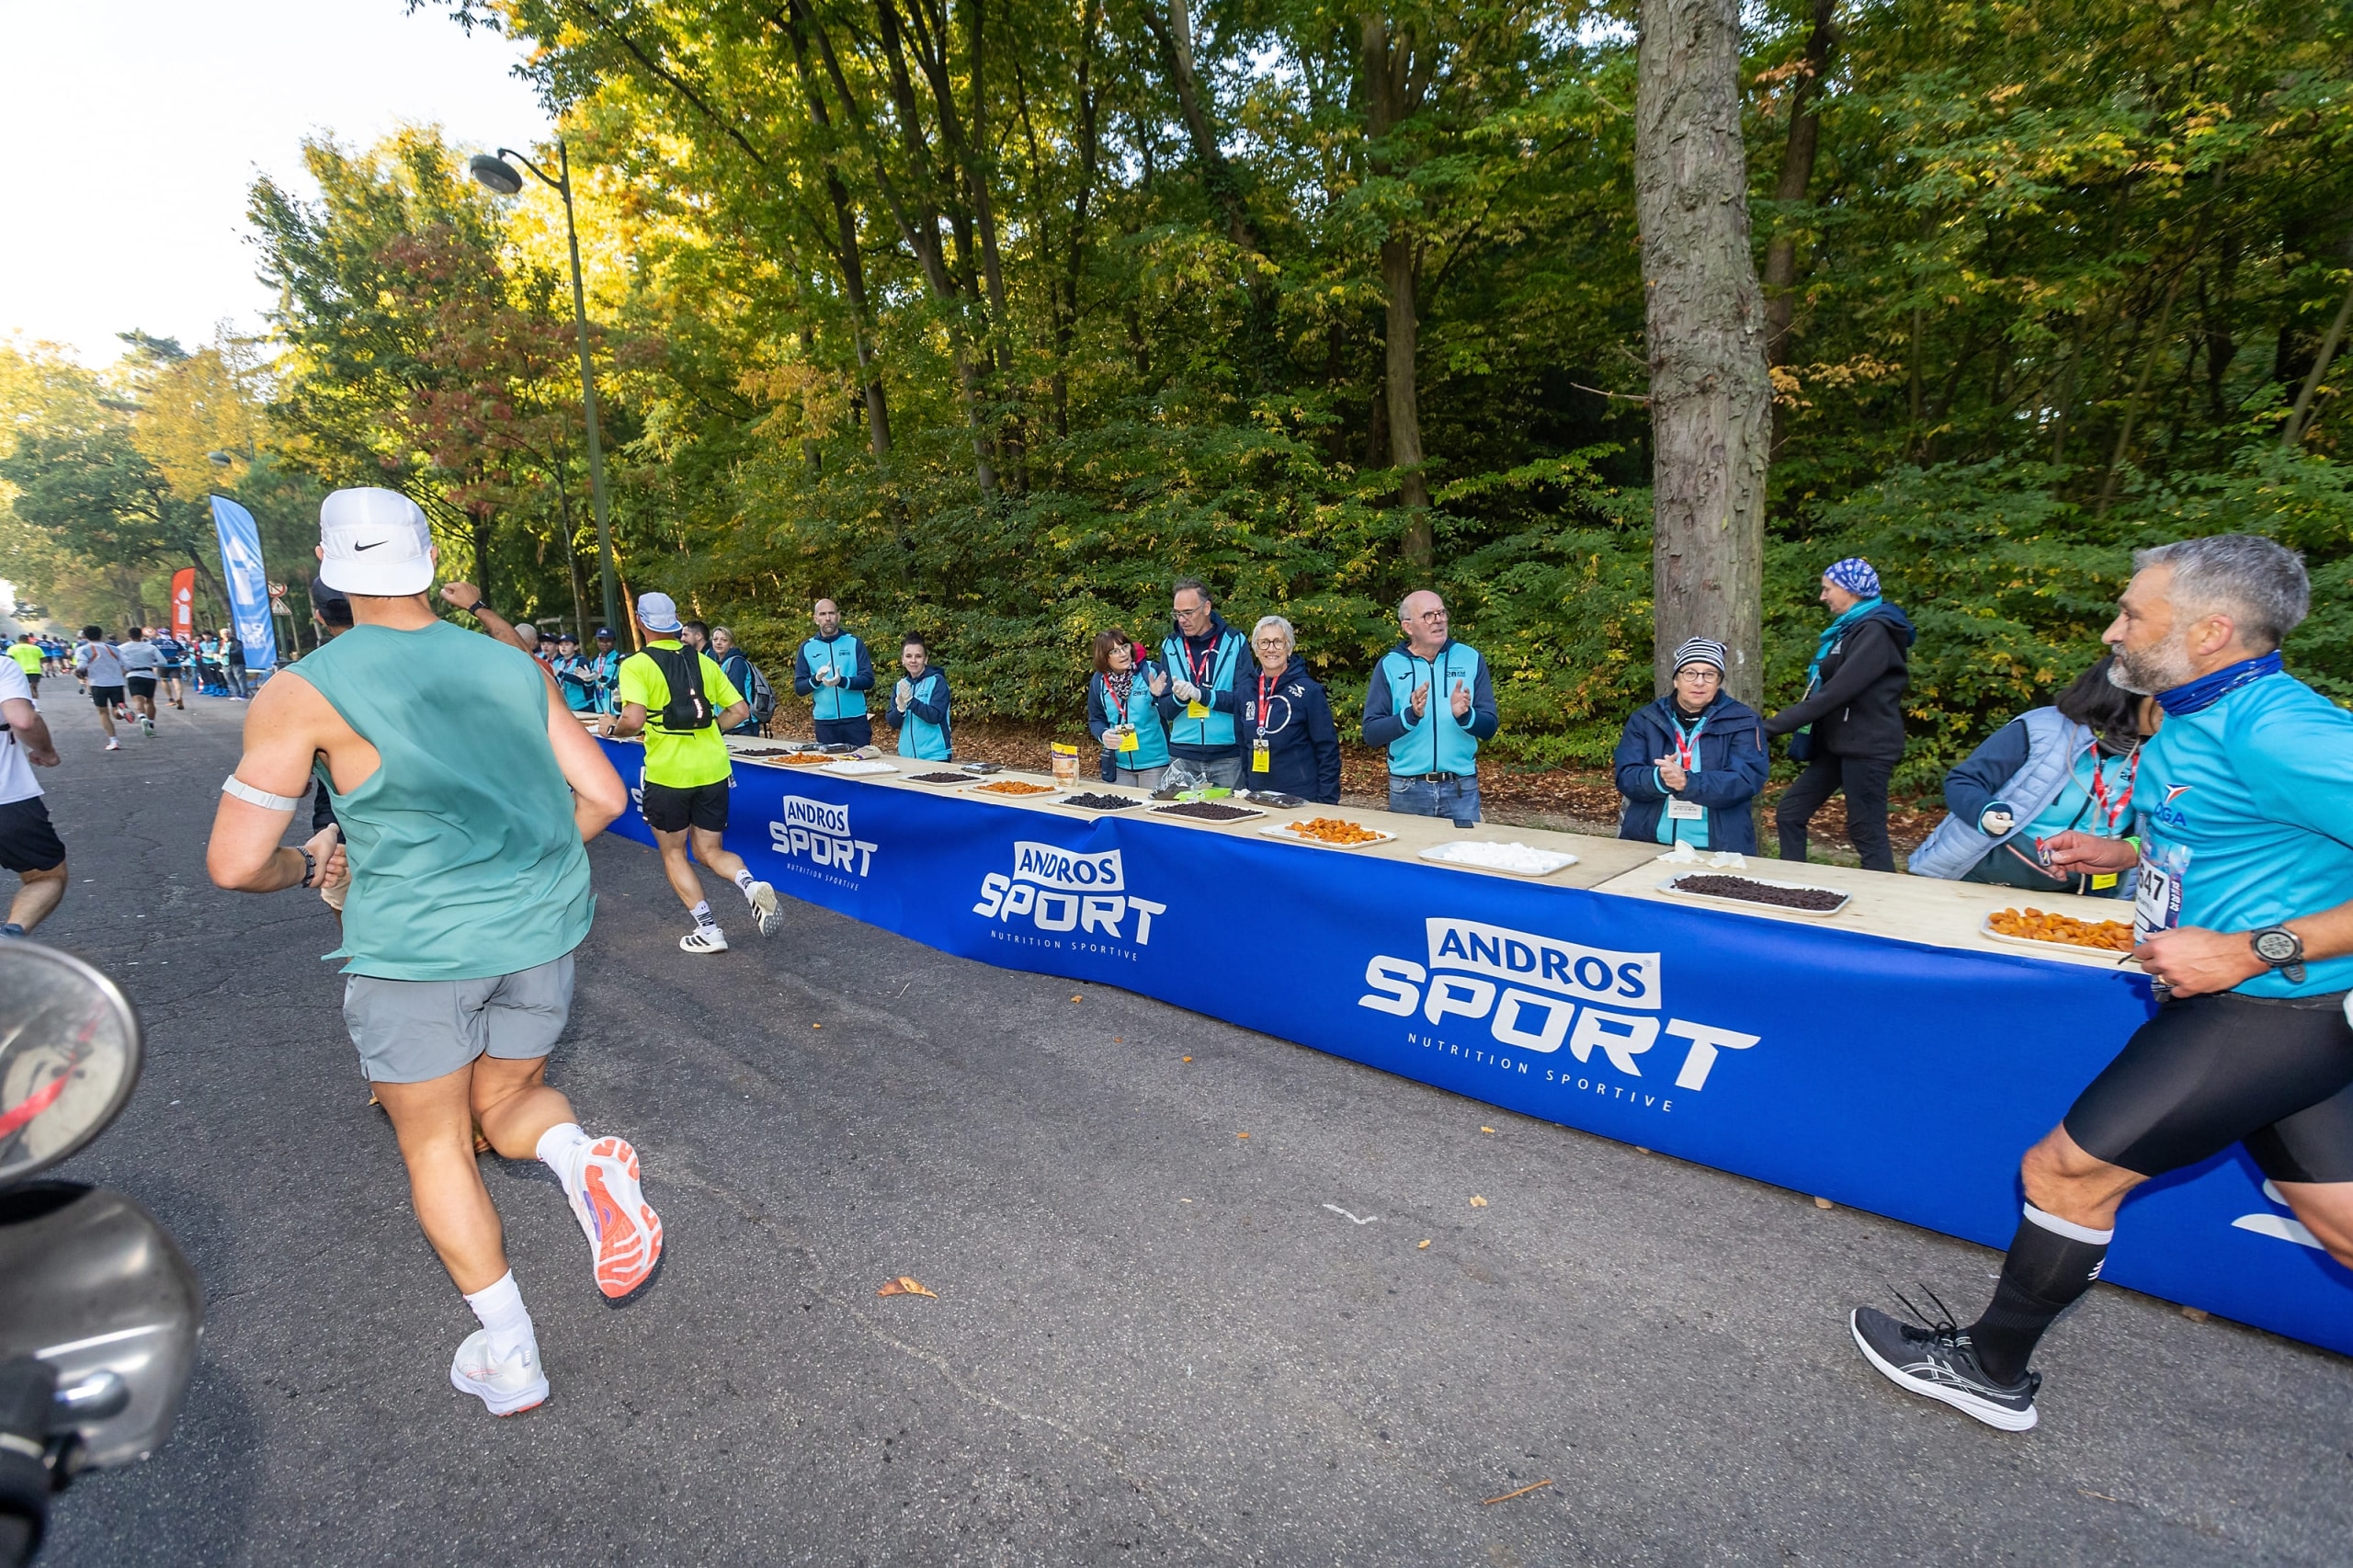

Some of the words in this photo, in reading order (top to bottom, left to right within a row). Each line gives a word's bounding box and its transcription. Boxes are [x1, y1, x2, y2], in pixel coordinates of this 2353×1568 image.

[788, 801, 846, 832] ANDROS
[768, 821, 879, 877] SPORT
[787, 862, 823, 880] NUTRITION
[824, 874, 859, 892] SPORTIVE
[1018, 848, 1117, 884] ANDROS
[972, 871, 1167, 946] SPORT
[990, 929, 1062, 949] NUTRITION
[1071, 941, 1138, 961] SPORTIVE
[1438, 928, 1647, 999] ANDROS
[1358, 954, 1762, 1091] SPORT
[1407, 1032, 1529, 1074] NUTRITION
[1545, 1069, 1673, 1112] SPORTIVE
